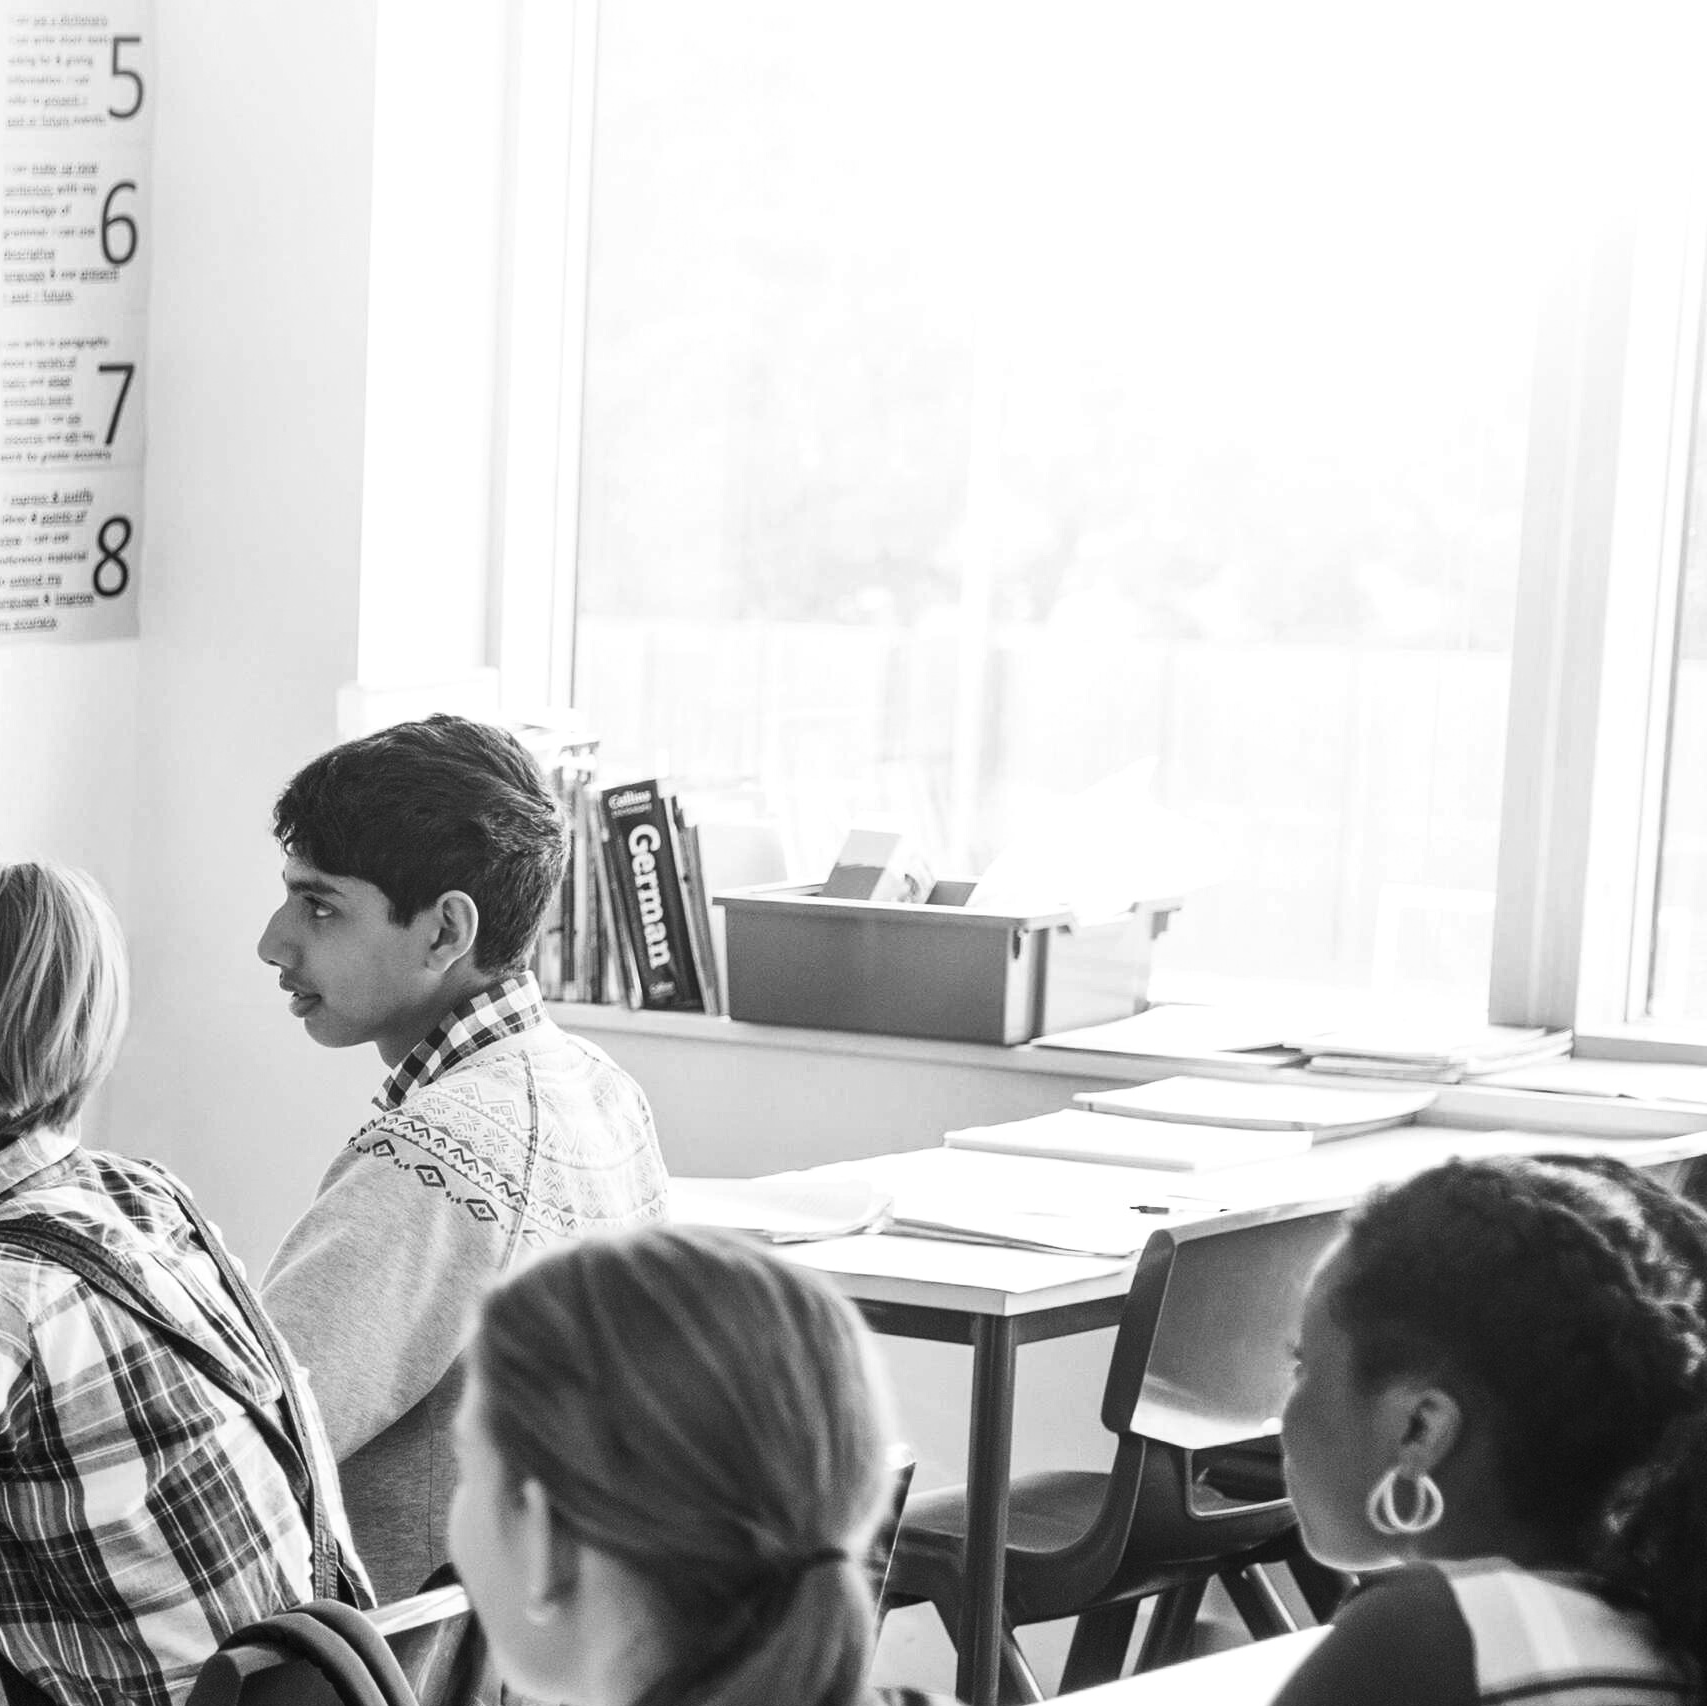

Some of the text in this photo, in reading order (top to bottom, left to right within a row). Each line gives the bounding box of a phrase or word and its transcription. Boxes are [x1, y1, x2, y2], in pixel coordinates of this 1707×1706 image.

[108, 34, 146, 120] 5
[99, 179, 139, 267] 6
[97, 361, 135, 446] 7
[92, 514, 133, 598] 8
[627, 823, 672, 971] German
